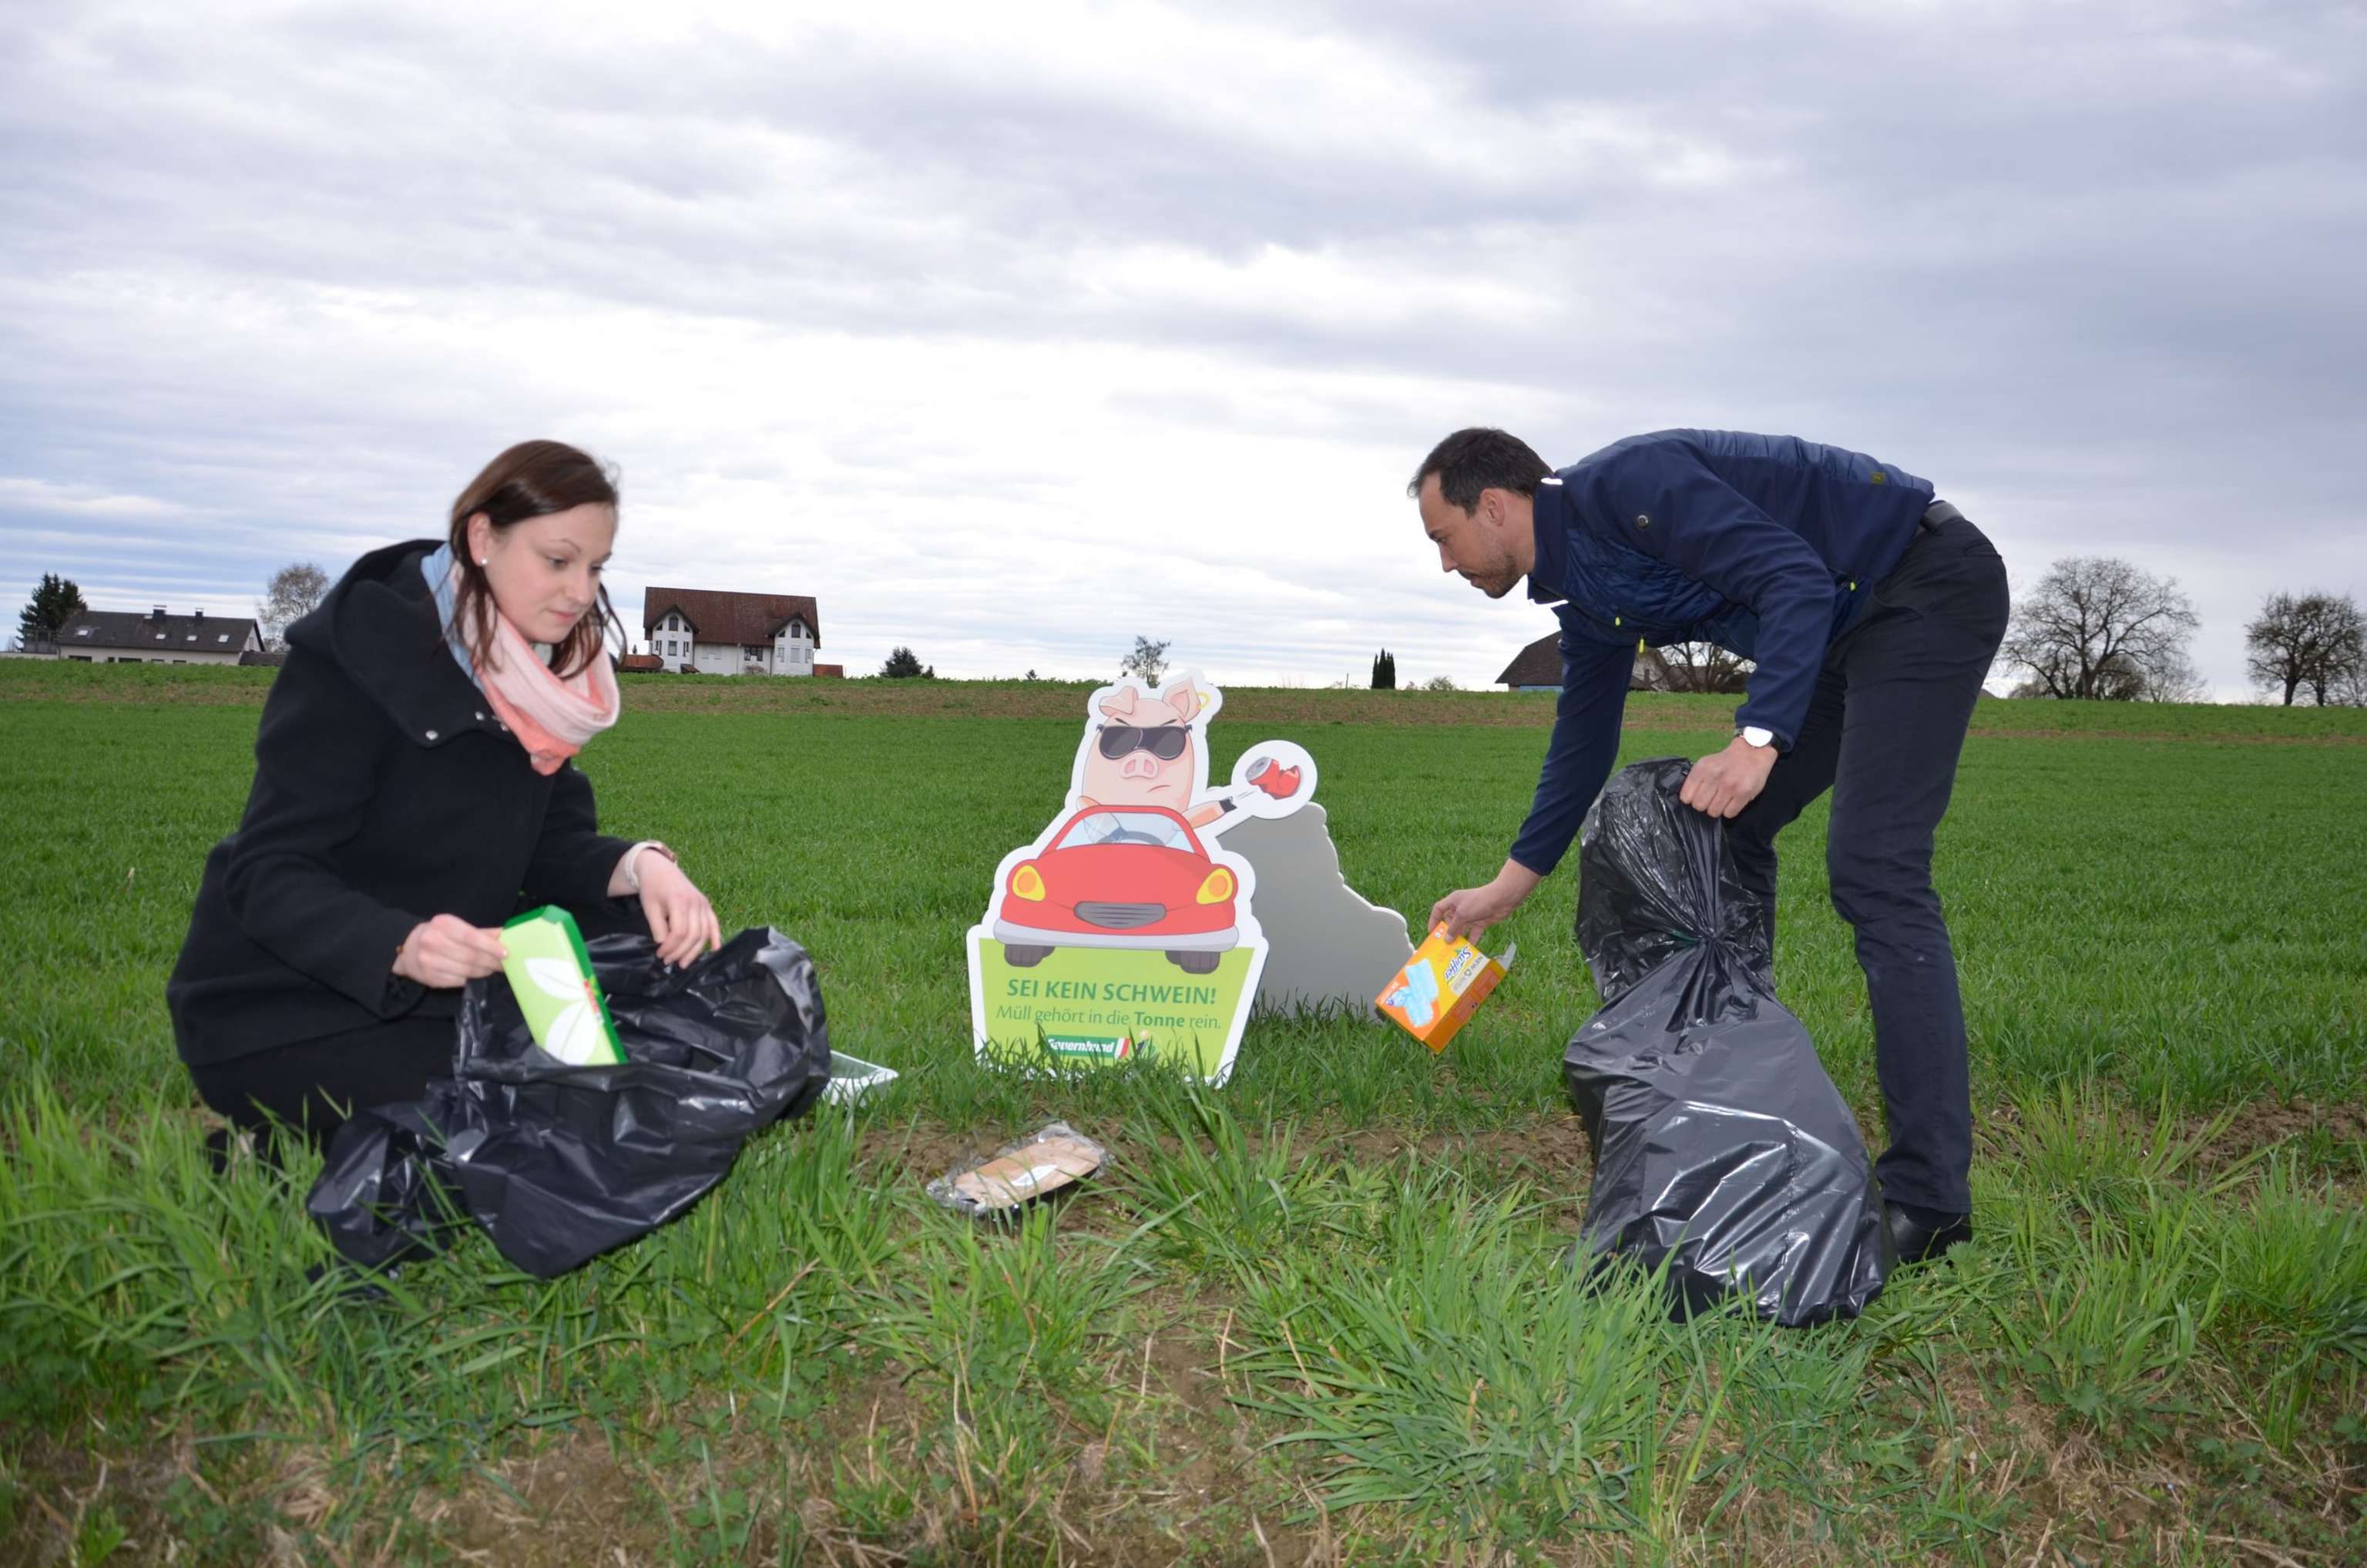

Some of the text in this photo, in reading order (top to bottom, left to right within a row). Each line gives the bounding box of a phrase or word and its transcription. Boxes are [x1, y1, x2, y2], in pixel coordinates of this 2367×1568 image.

[1444, 947, 1471, 980] Swiffer
[1007, 979, 1216, 1005] SEI KEIN SCHWEIN!
[995, 1006, 1220, 1029] Müll gehört in die Tonne rein.
